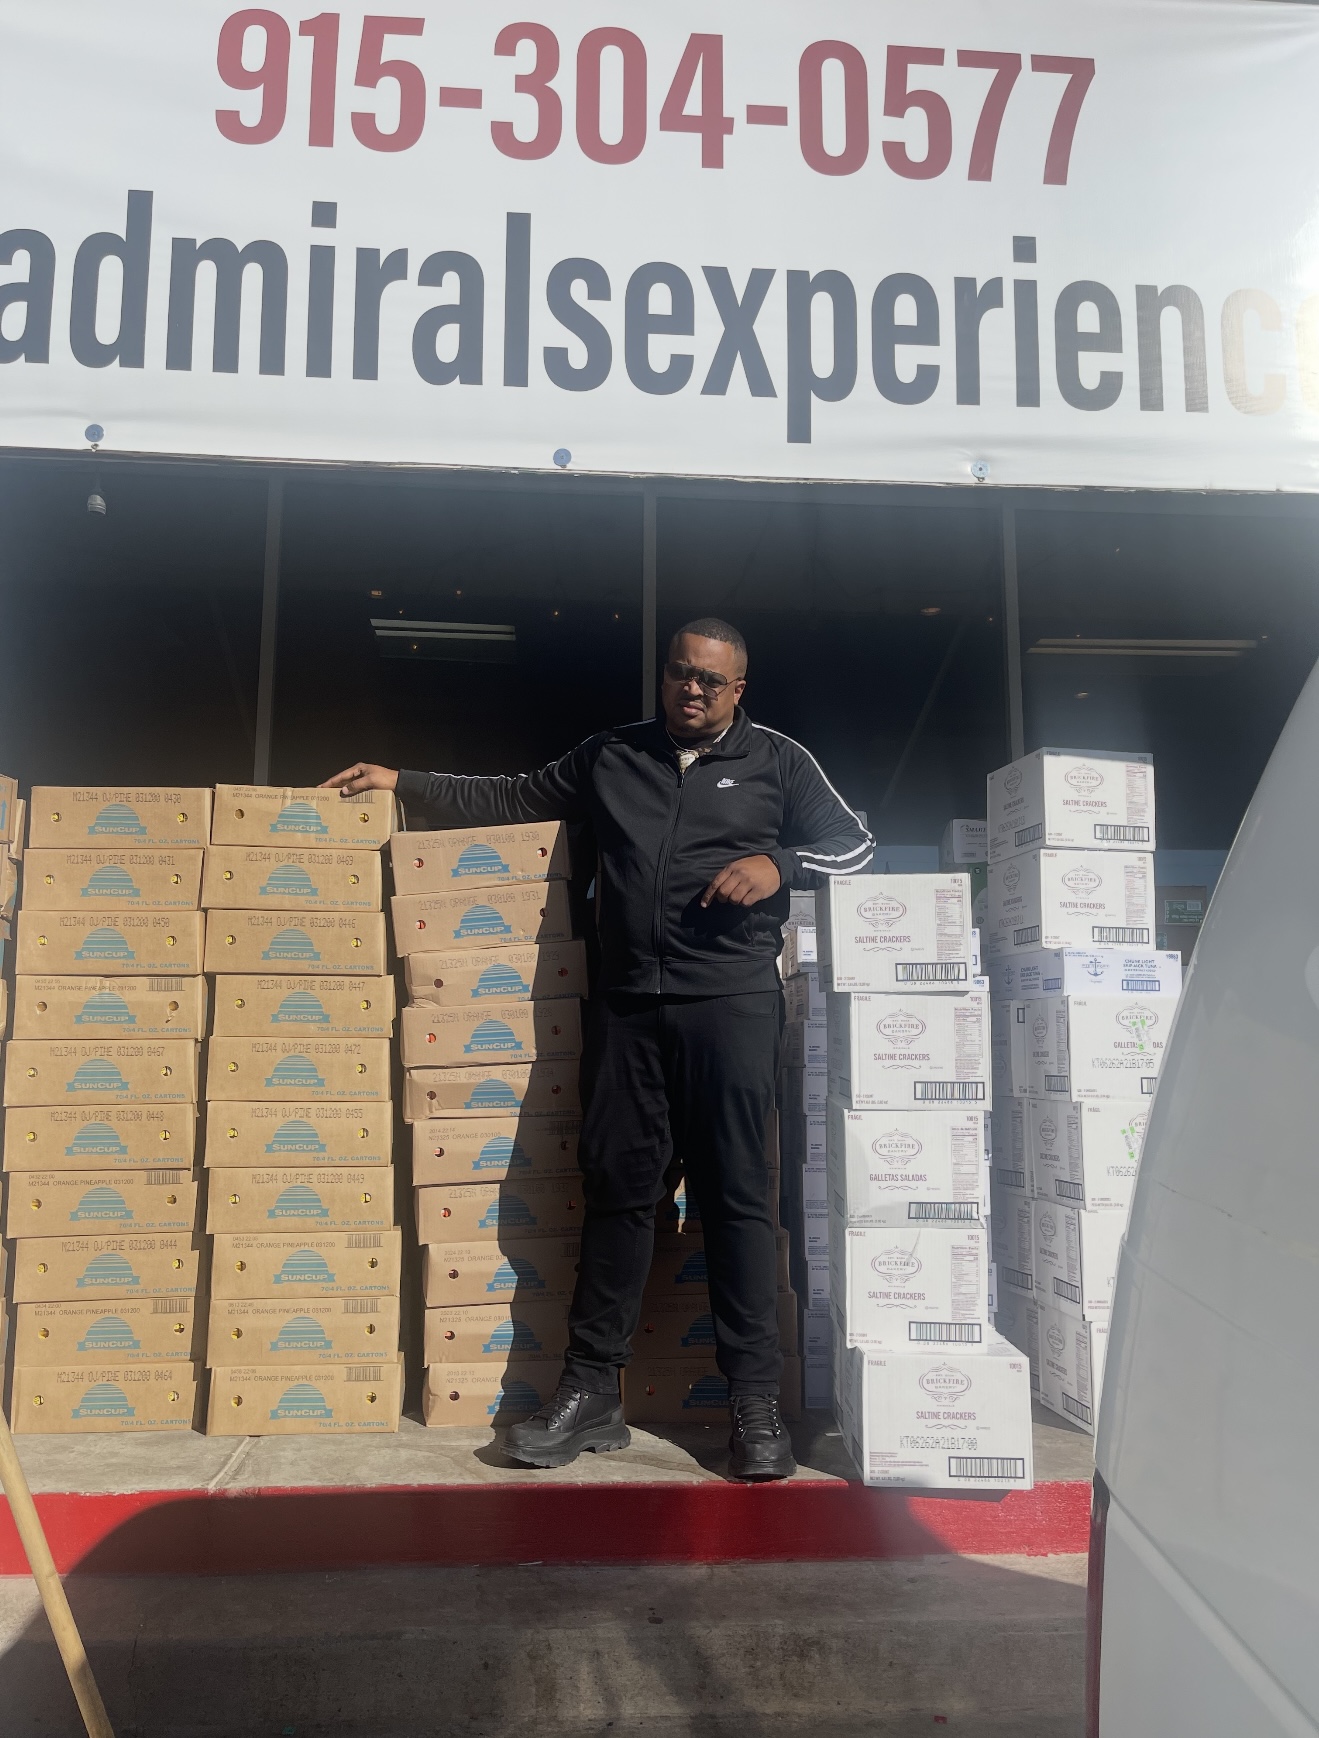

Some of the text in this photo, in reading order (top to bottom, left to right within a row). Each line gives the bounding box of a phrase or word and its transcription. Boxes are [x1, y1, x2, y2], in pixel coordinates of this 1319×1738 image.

[214, 8, 1096, 187] 915-304-0577
[880, 935, 911, 943] CRACKERS
[874, 1053, 930, 1061] SALTINE CRACKERS
[868, 1291, 925, 1300] SALTINE CRACKERS
[916, 1411, 976, 1420] SALTINE CRACKERS
